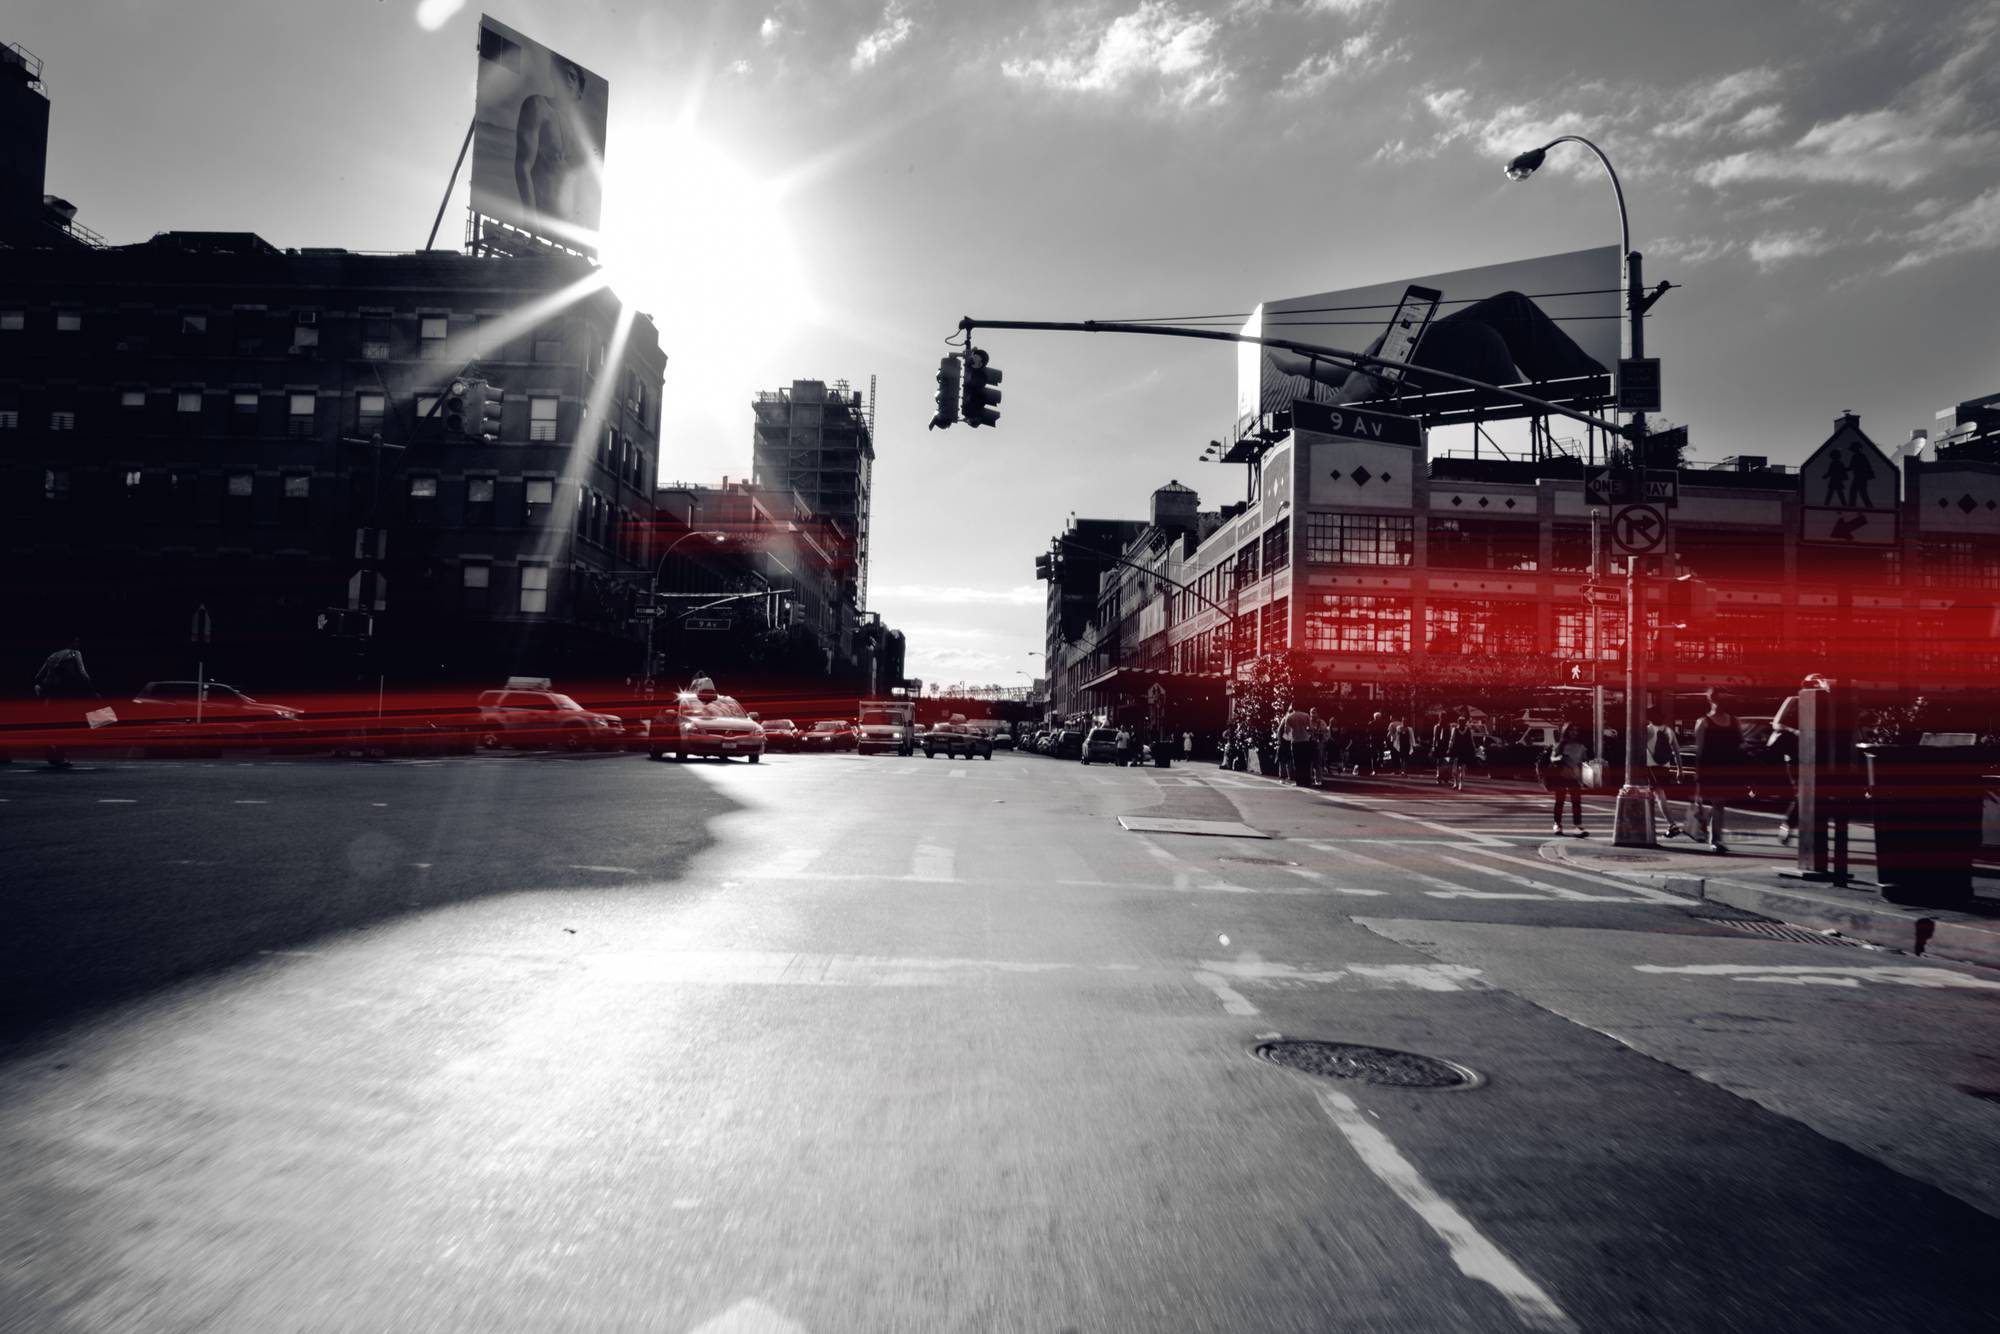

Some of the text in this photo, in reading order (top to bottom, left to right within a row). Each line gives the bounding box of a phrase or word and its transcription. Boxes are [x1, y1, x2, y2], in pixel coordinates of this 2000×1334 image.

[1330, 412, 1382, 436] 9 Av
[1593, 480, 1618, 493] ONE
